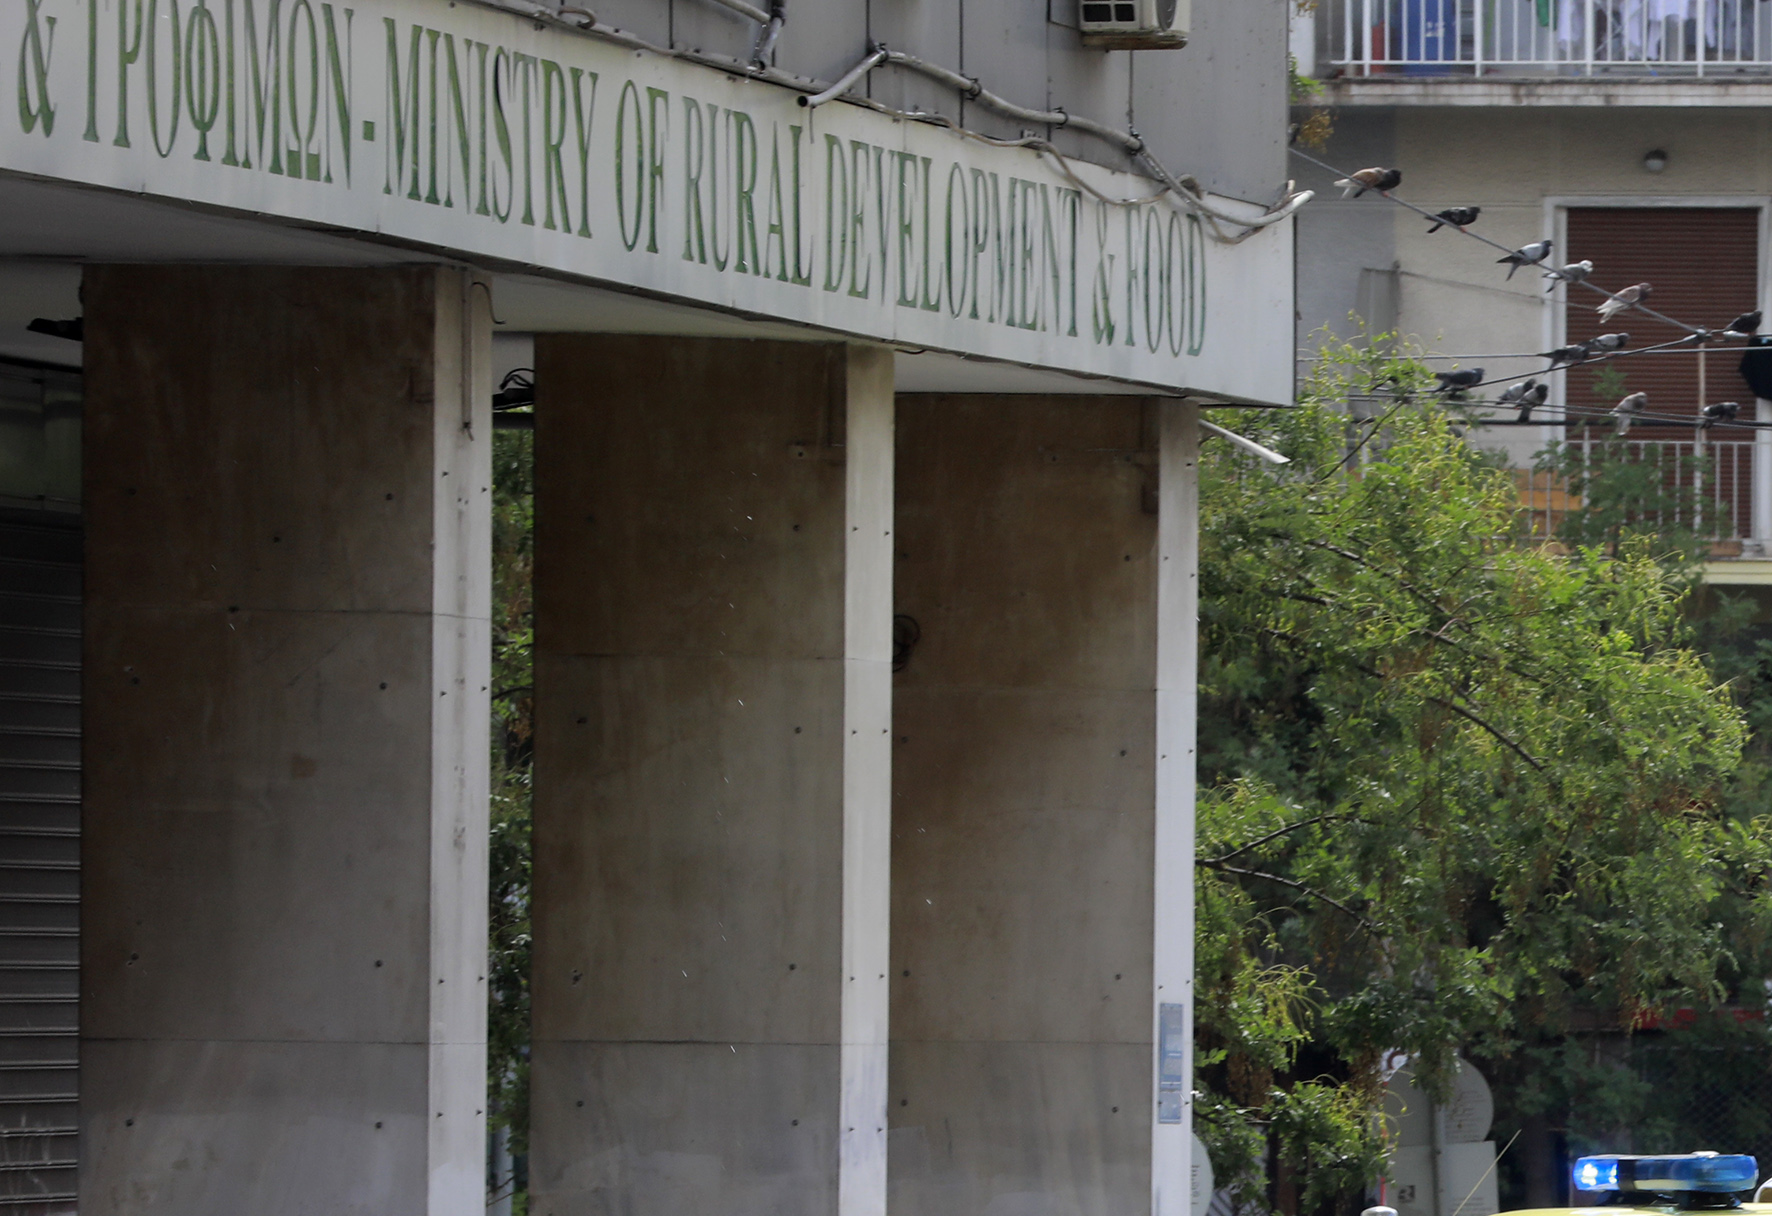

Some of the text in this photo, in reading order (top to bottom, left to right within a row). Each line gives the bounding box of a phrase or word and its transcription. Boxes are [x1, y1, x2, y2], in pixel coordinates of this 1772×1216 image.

[18, 0, 57, 138] &
[614, 79, 670, 255] OF
[682, 96, 812, 288] RURAL
[823, 132, 1083, 338] DEVELOPMENT
[1092, 195, 1117, 347] &
[1124, 202, 1208, 358] FOOD
